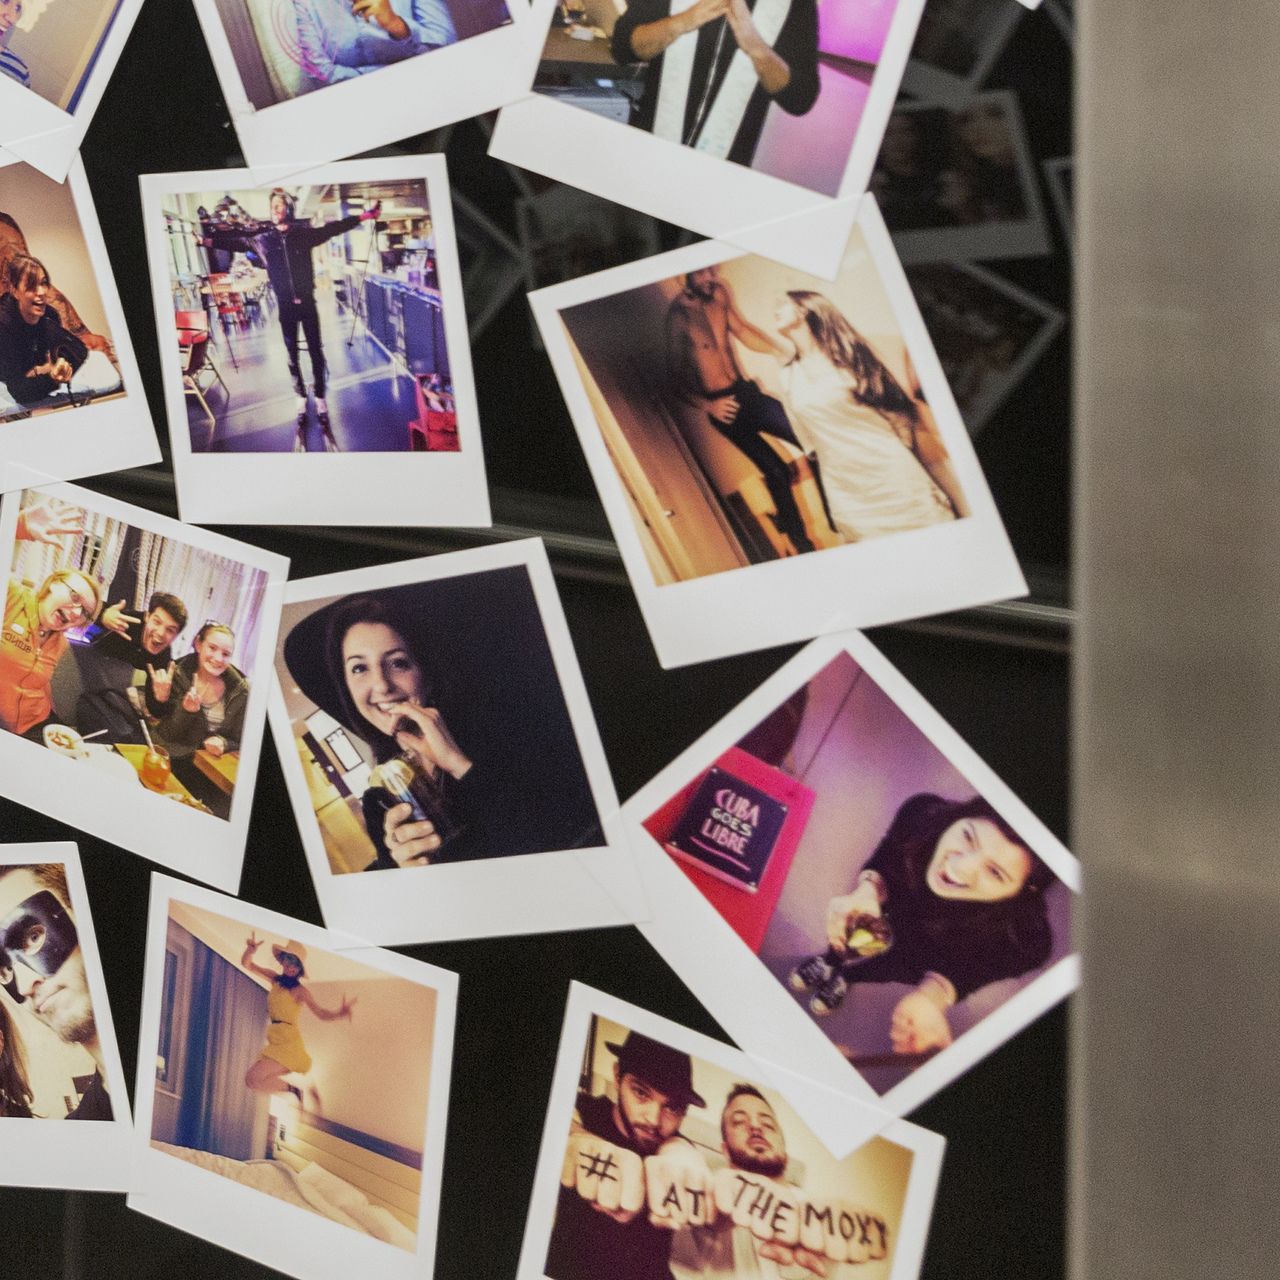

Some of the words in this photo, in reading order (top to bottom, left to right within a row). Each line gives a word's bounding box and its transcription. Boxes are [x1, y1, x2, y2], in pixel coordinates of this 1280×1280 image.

[710, 807, 753, 837] GOES
[715, 788, 761, 828] CUBA
[700, 818, 749, 855] LIBRE
[579, 1151, 619, 1183] #
[662, 1181, 706, 1218] AT
[733, 1175, 793, 1233] THE
[804, 1201, 889, 1253] MOXY
